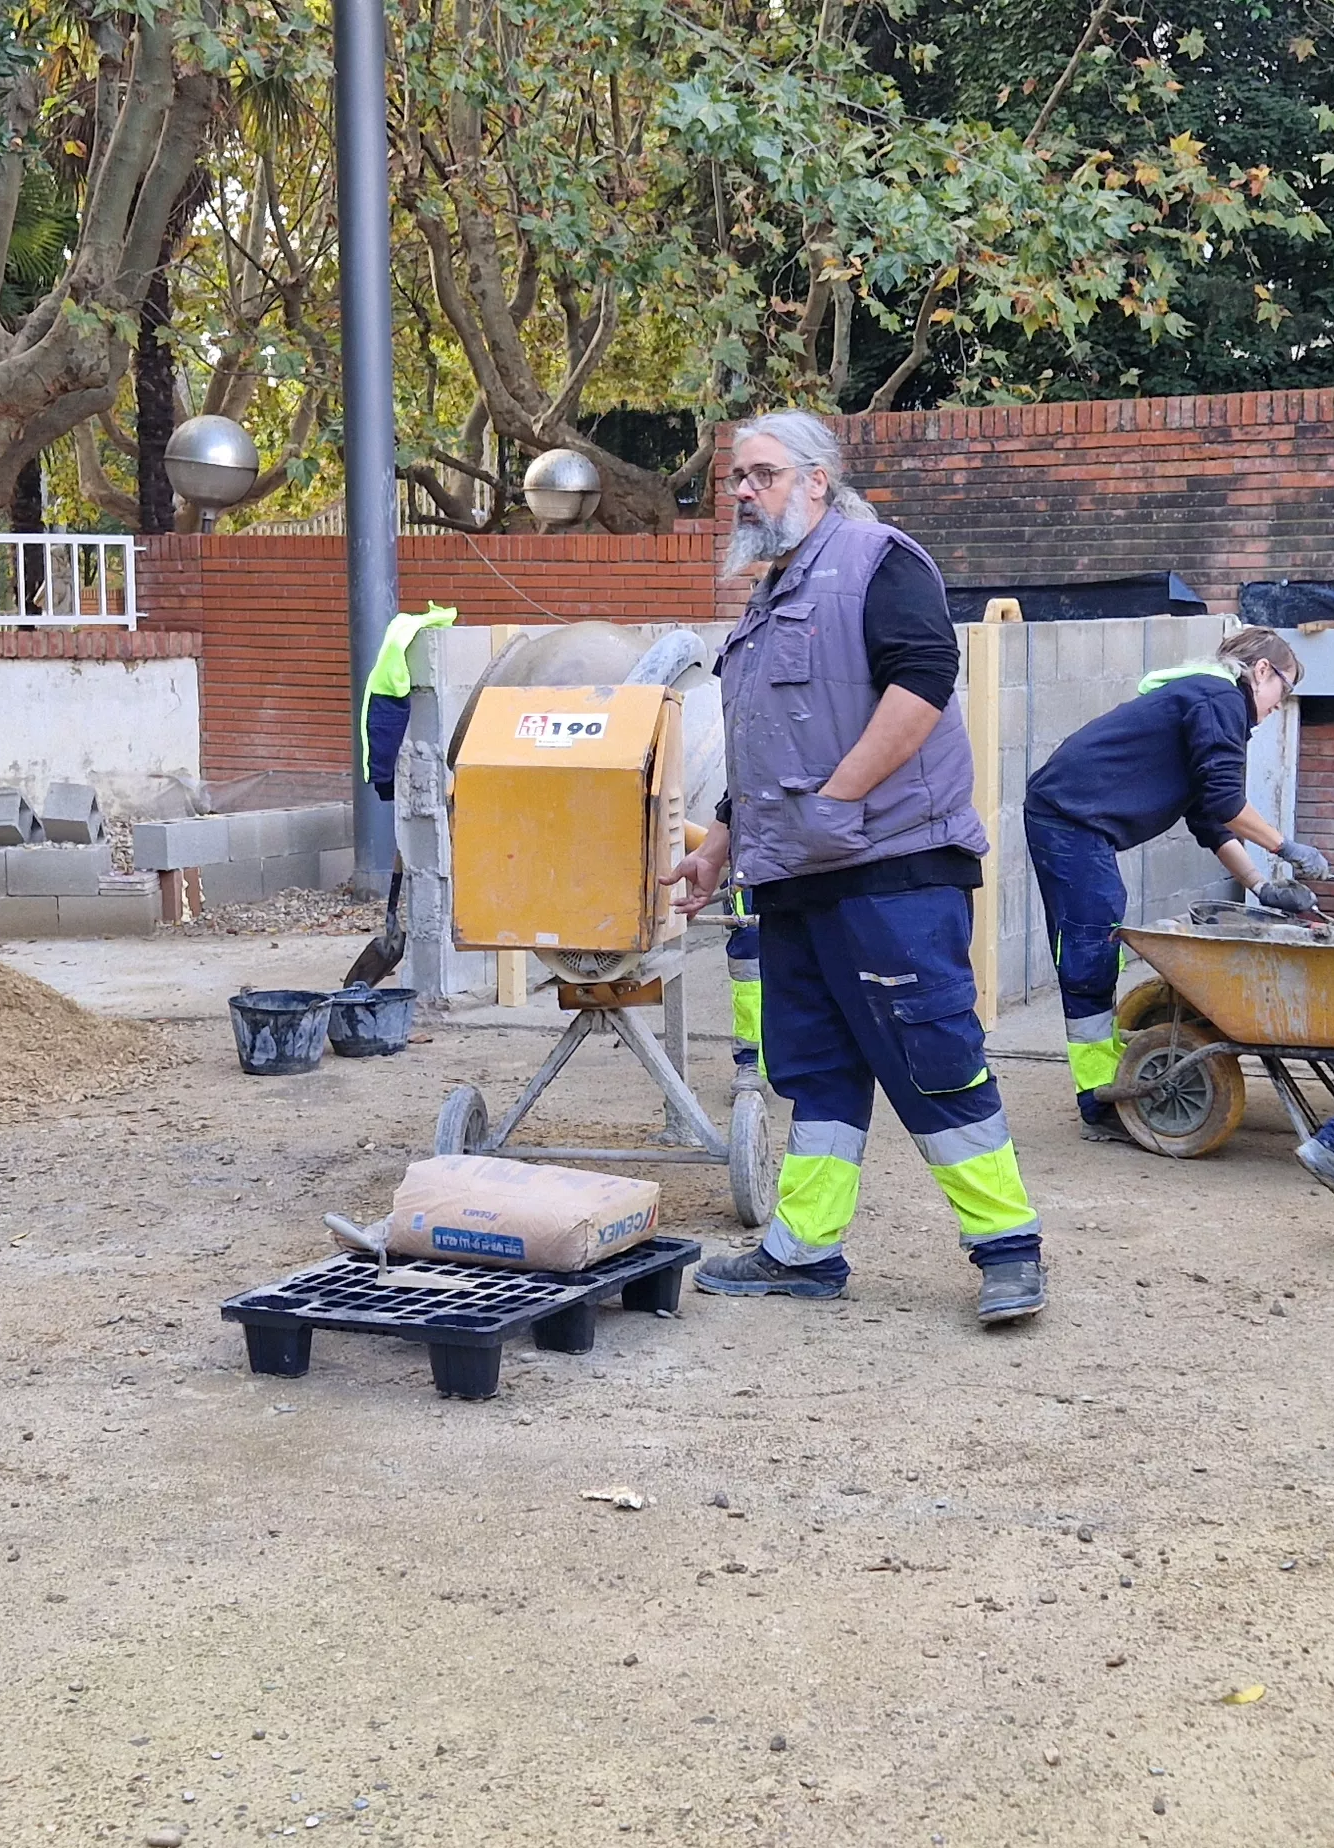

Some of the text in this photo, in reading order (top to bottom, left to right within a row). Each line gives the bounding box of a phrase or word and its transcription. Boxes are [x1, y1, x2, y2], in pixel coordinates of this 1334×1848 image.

[552, 722, 602, 736] 190
[462, 1208, 493, 1220] CEMEX
[597, 1211, 644, 1245] CEMEX
